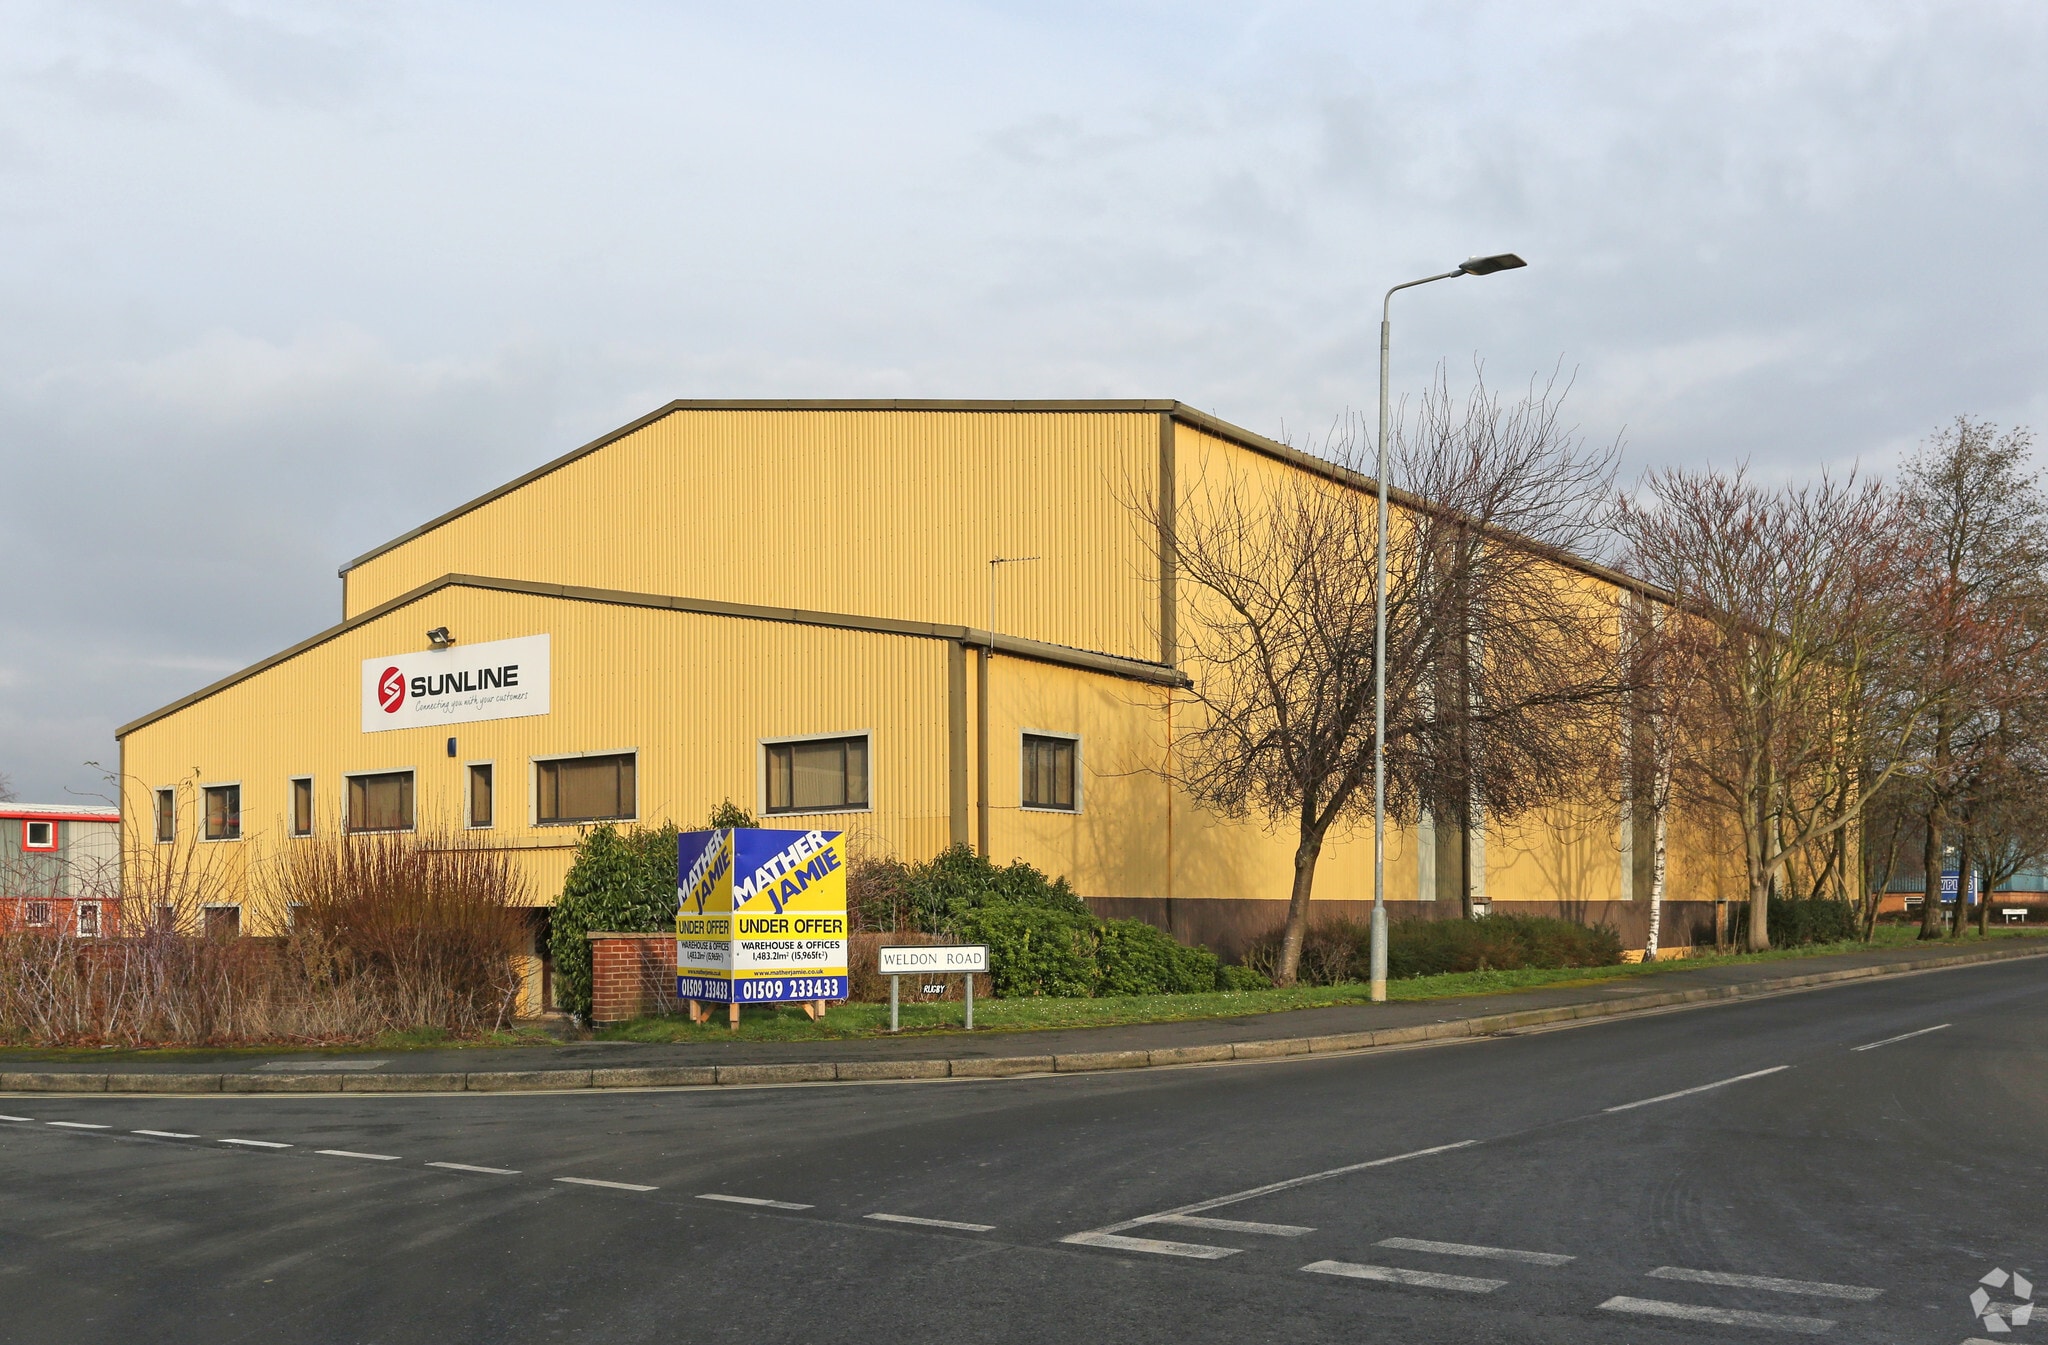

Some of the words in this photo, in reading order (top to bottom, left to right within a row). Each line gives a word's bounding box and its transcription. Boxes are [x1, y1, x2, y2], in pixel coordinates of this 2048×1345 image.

[411, 665, 519, 697] SUNLINE
[415, 699, 449, 713] Connecting
[446, 700, 463, 713] you
[463, 695, 478, 706] with
[476, 695, 494, 710] your
[495, 691, 528, 702] customers
[678, 829, 725, 908] MATHER
[734, 830, 829, 907] MATHER
[695, 845, 731, 915] JAMIE
[767, 846, 841, 914] JAMIE
[679, 920, 704, 934] UNDER
[707, 920, 729, 935] OFFER
[739, 919, 789, 933] UNDER
[794, 919, 842, 933] OFFER
[681, 941, 708, 950] WAREHOUSE
[708, 942, 712, 950] &
[712, 942, 729, 951] OFFICES
[741, 941, 794, 950] WAREHOUSE
[797, 941, 803, 950] &
[806, 940, 840, 949] OFFICES
[884, 953, 937, 965] WELDON
[947, 953, 982, 964] ROAD
[682, 979, 703, 997] 01509
[705, 980, 728, 999] 233433
[743, 980, 783, 999] 01509
[789, 979, 838, 998] 233433
[923, 985, 945, 994] RUGBY
